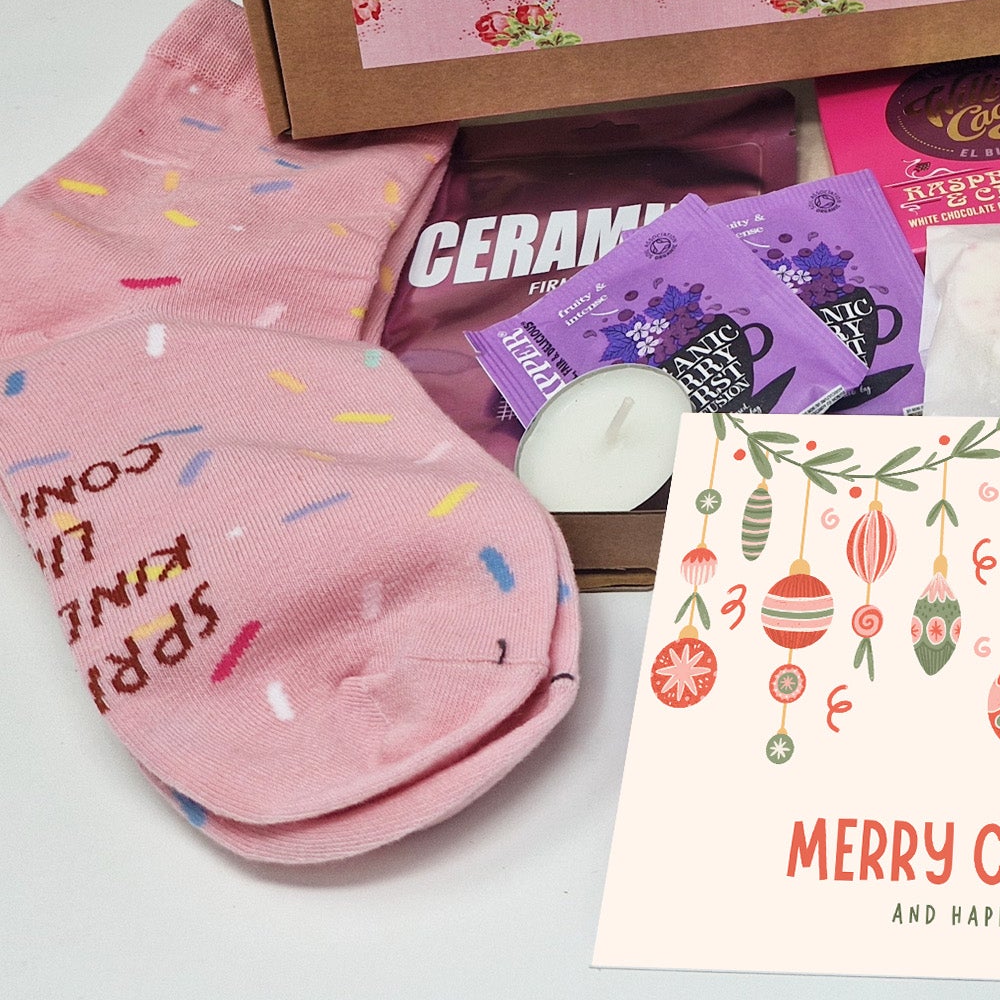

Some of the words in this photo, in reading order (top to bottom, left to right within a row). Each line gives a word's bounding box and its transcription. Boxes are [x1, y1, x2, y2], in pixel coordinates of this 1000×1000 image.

[959, 148, 978, 158] EL
[908, 214, 939, 228] WHITE
[941, 204, 996, 222] CHOCOLATE
[947, 192, 967, 208] &
[726, 218, 749, 230] uity
[754, 213, 765, 222] &
[736, 226, 764, 239] ense
[408, 203, 678, 288] CERAM
[557, 292, 592, 319] fruity
[595, 282, 607, 293] &
[564, 294, 608, 327] intense
[556, 358, 570, 377] FAIR
[662, 324, 740, 379] ANIC
[678, 343, 738, 397] RRY
[690, 360, 746, 410] RST
[88, 581, 221, 715] SPRI
[785, 816, 955, 885] MERRY
[891, 902, 937, 926] AND
